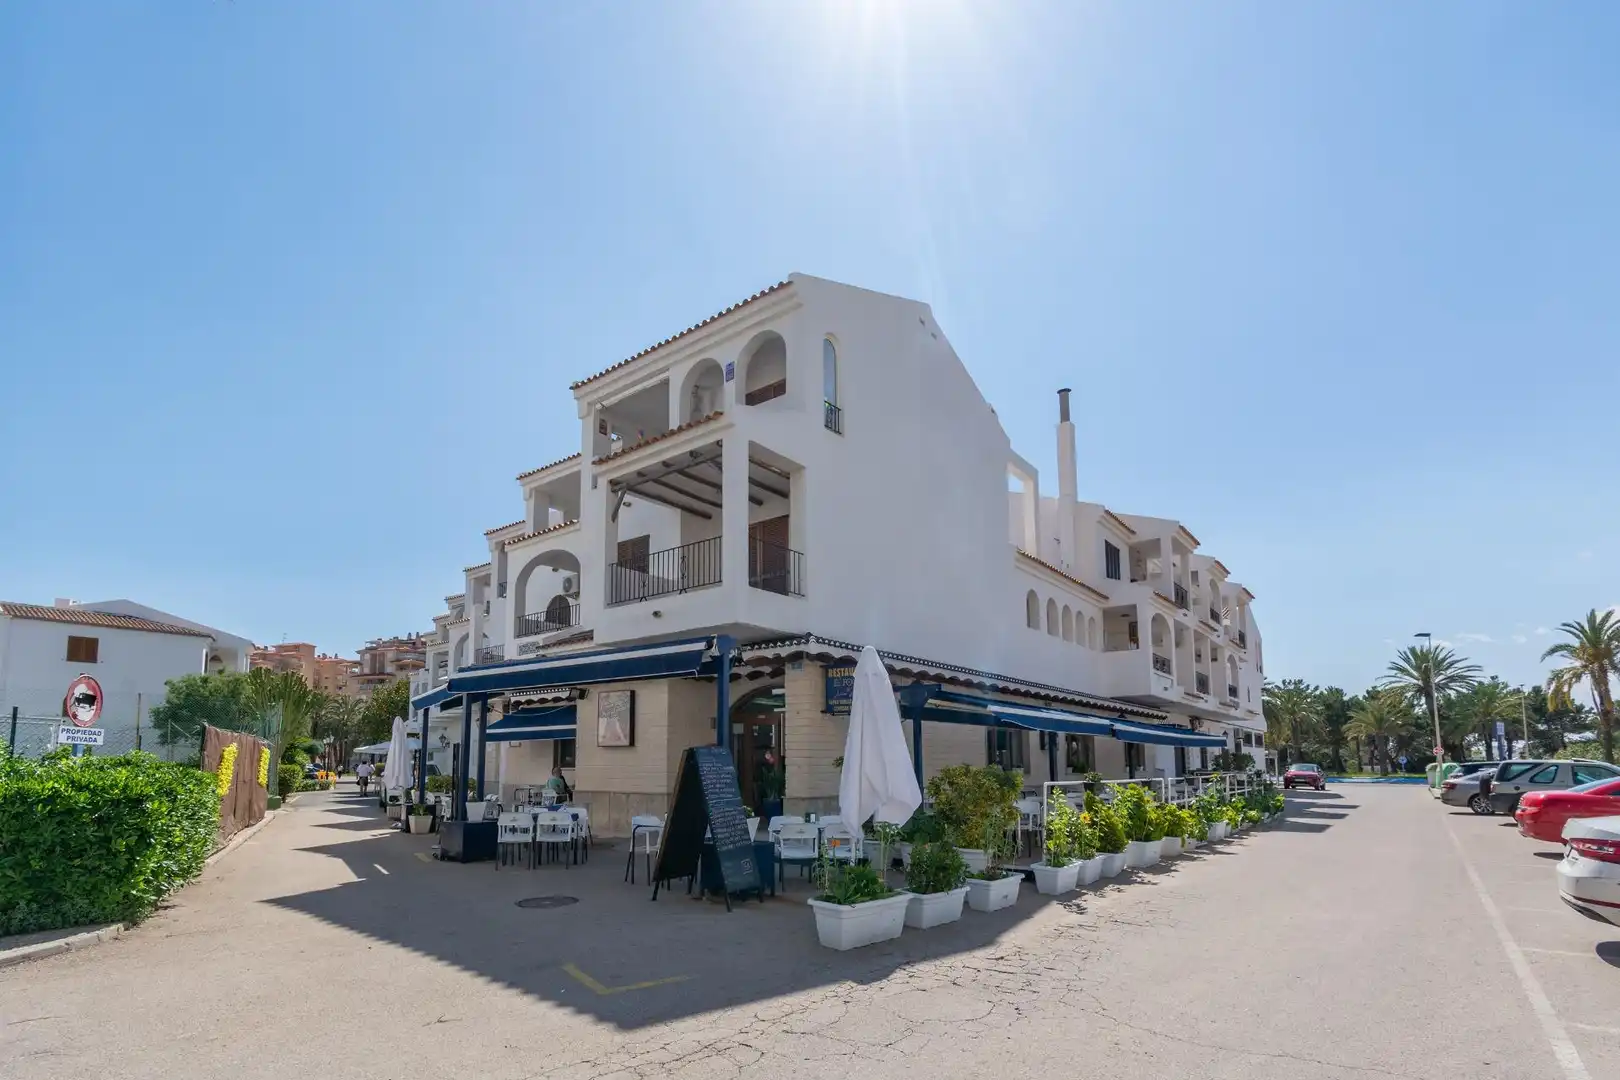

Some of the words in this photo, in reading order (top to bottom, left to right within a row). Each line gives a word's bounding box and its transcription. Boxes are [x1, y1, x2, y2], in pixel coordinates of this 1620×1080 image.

[828, 667, 856, 677] RESTAU
[61, 728, 102, 736] PROPIEDAD
[66, 735, 98, 743] PRIVADA
